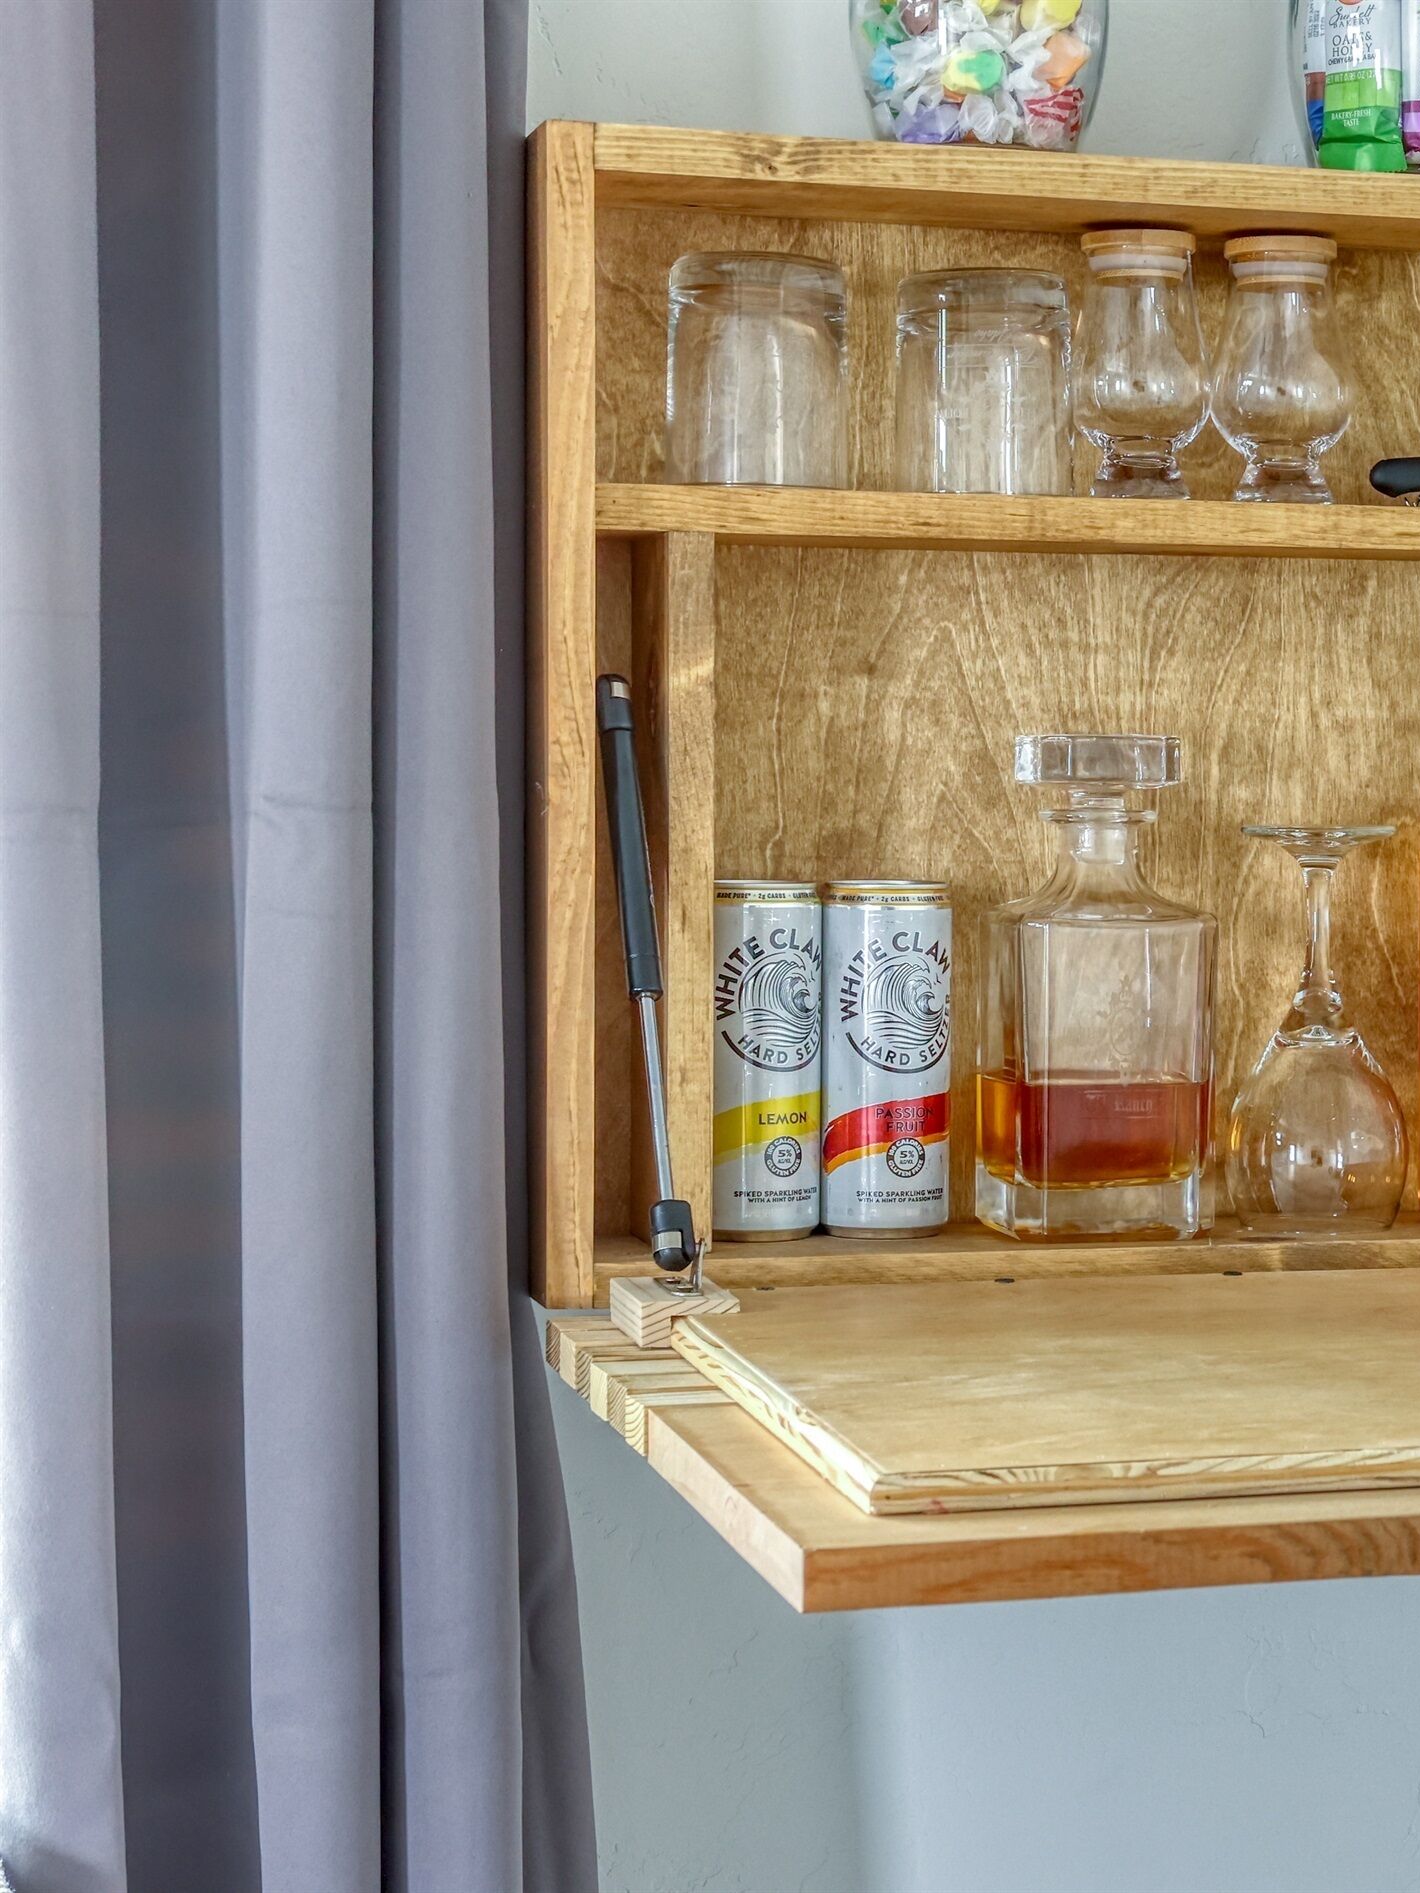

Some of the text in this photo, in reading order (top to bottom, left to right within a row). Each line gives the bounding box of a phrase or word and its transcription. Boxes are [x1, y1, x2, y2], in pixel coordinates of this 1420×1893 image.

[1332, 43, 1372, 57] HOY
[1331, 109, 1371, 120] BAKERY-FRESH
[1343, 119, 1360, 127] TASTE
[715, 928, 821, 1020] WHITE CLAW
[840, 931, 950, 1022] WHITE CLAW
[737, 1034, 788, 1064] HARD
[861, 1036, 910, 1065] HARD
[758, 1111, 807, 1125] LEMON
[875, 1107, 932, 1119] PASSION
[886, 1121, 926, 1132] FRUIT
[777, 1149, 792, 1158] 5%
[899, 1150, 914, 1158] 5%
[767, 1159, 789, 1176] GLUTEN
[888, 1160, 911, 1176] GLUTEN
[733, 1190, 762, 1198] SPIKED
[764, 1188, 802, 1197] SPARKLING
[856, 1187, 943, 1198] SPIKED SPARKLING WATER
